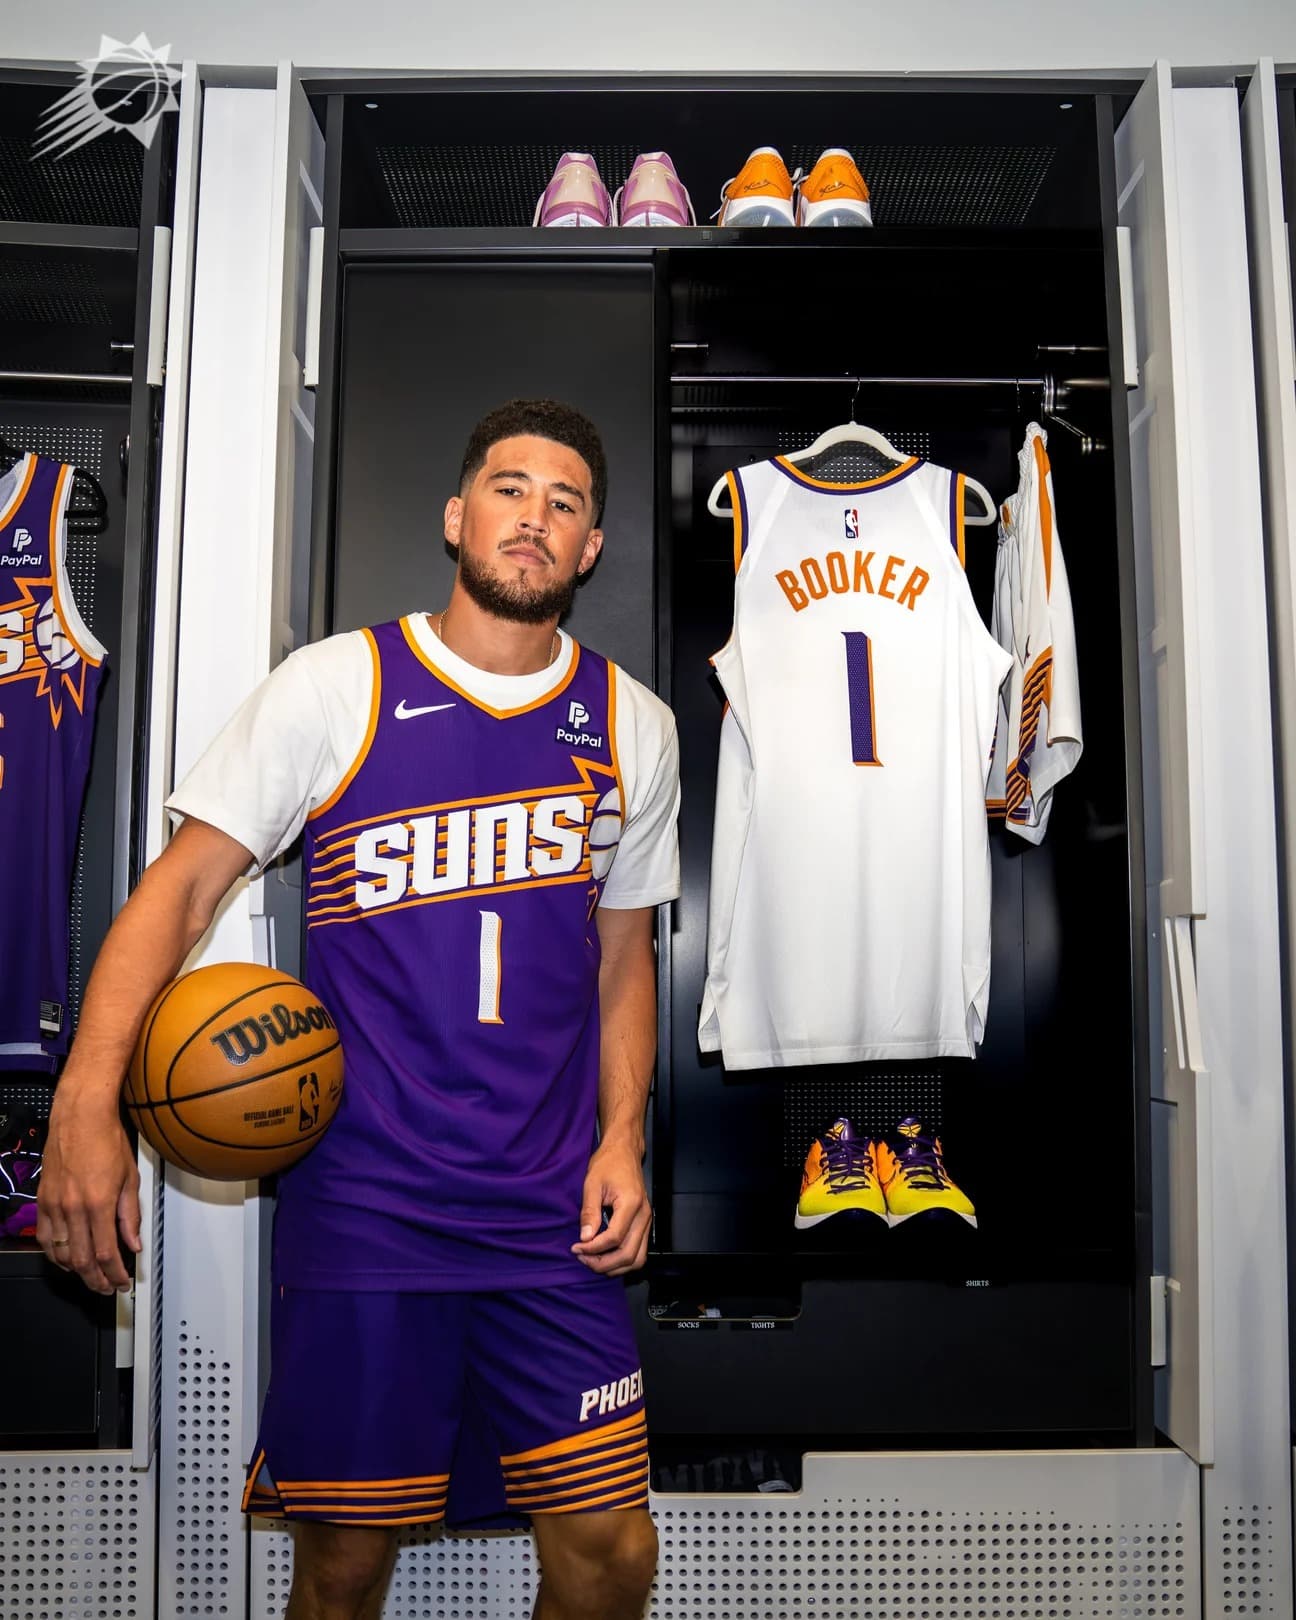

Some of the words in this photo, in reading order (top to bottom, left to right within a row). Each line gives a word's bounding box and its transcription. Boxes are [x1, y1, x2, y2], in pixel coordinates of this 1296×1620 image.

[0, 554, 42, 567] PayPal
[775, 550, 930, 613] BOOKER
[841, 631, 884, 767] 1
[556, 728, 602, 748] PayPal
[354, 795, 585, 910] SUNS
[477, 910, 505, 1024] 1
[209, 1003, 336, 1066] Wilson
[965, 1279, 990, 1287] SHIRTS
[677, 1321, 700, 1329] SOCKS
[750, 1321, 775, 1329] TIGHTS
